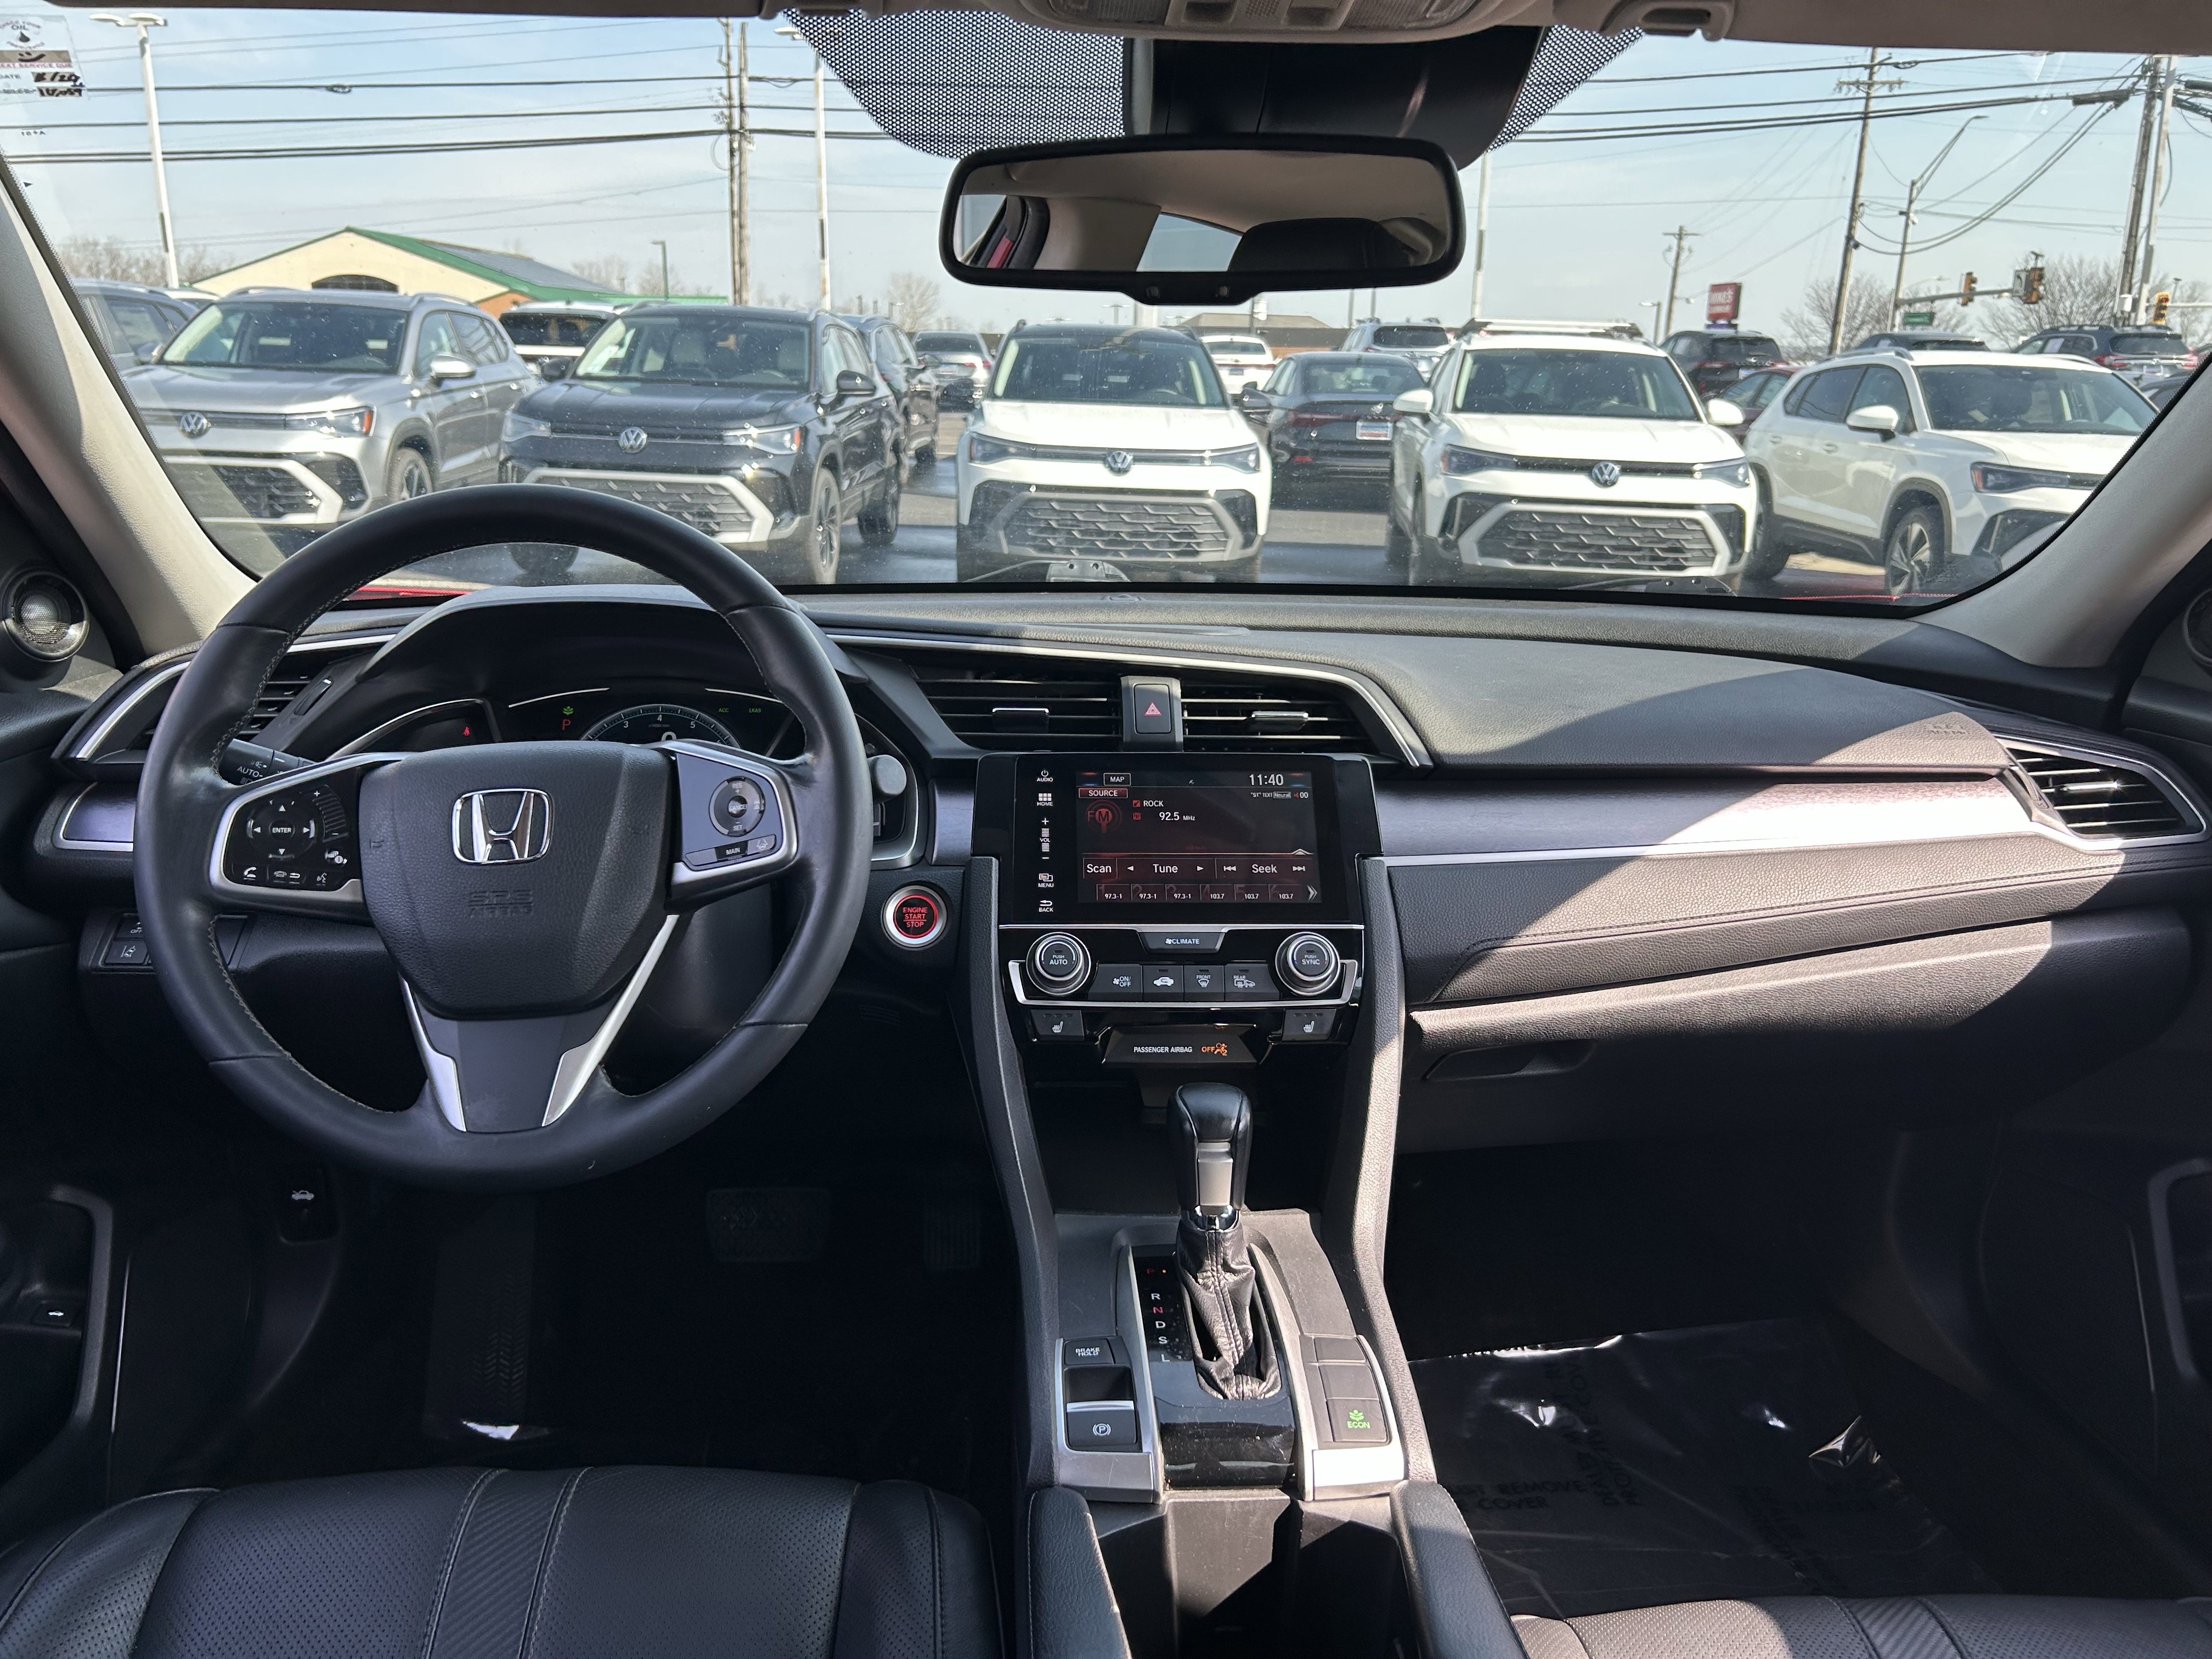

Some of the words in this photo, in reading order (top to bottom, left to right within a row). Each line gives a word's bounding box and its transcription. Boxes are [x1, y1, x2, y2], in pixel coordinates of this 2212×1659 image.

[562, 719, 571, 730] P
[236, 765, 259, 777] AUTO
[1249, 774, 1284, 786] 11:40
[1159, 812, 1180, 821] 92.5
[1086, 864, 1111, 873] Scan
[1153, 864, 1178, 873] Tune
[1252, 864, 1277, 873] Seek
[1161, 1354, 1170, 1362] L
